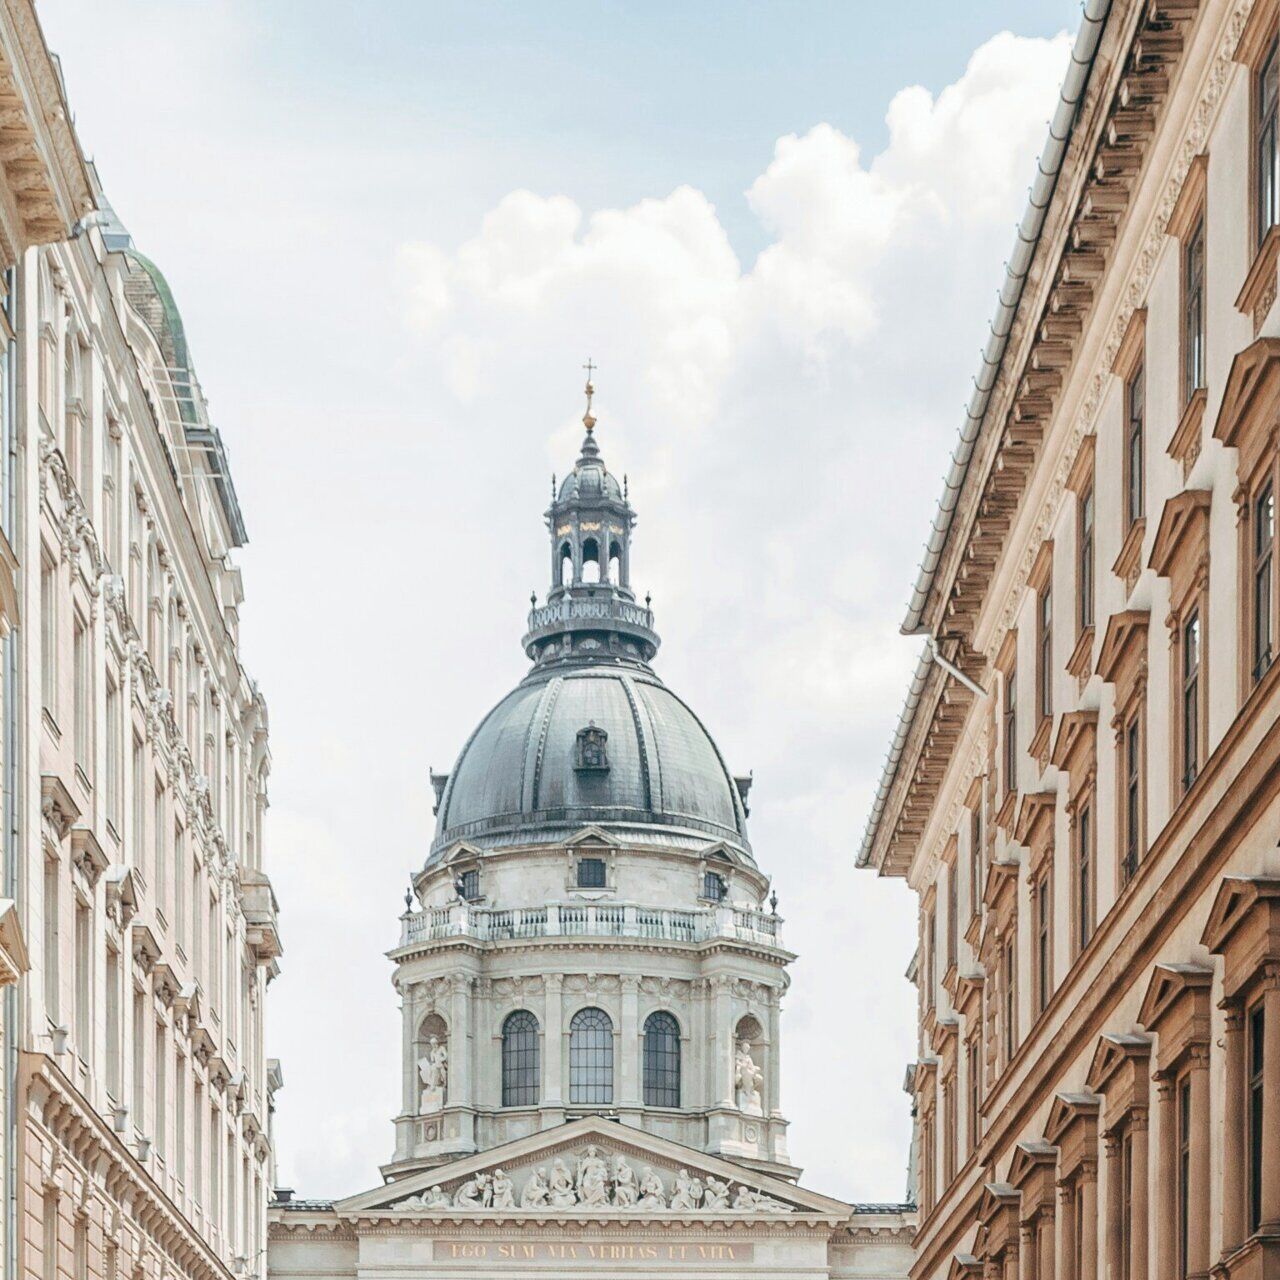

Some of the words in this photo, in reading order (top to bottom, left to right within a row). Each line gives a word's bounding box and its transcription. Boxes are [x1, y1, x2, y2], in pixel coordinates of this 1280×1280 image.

[450, 1243, 486, 1258] EGO
[498, 1243, 535, 1258] SUM
[548, 1244, 577, 1258] VIA
[588, 1245, 658, 1259] VERITAS
[668, 1245, 687, 1259] ET
[698, 1245, 735, 1259] VITA
